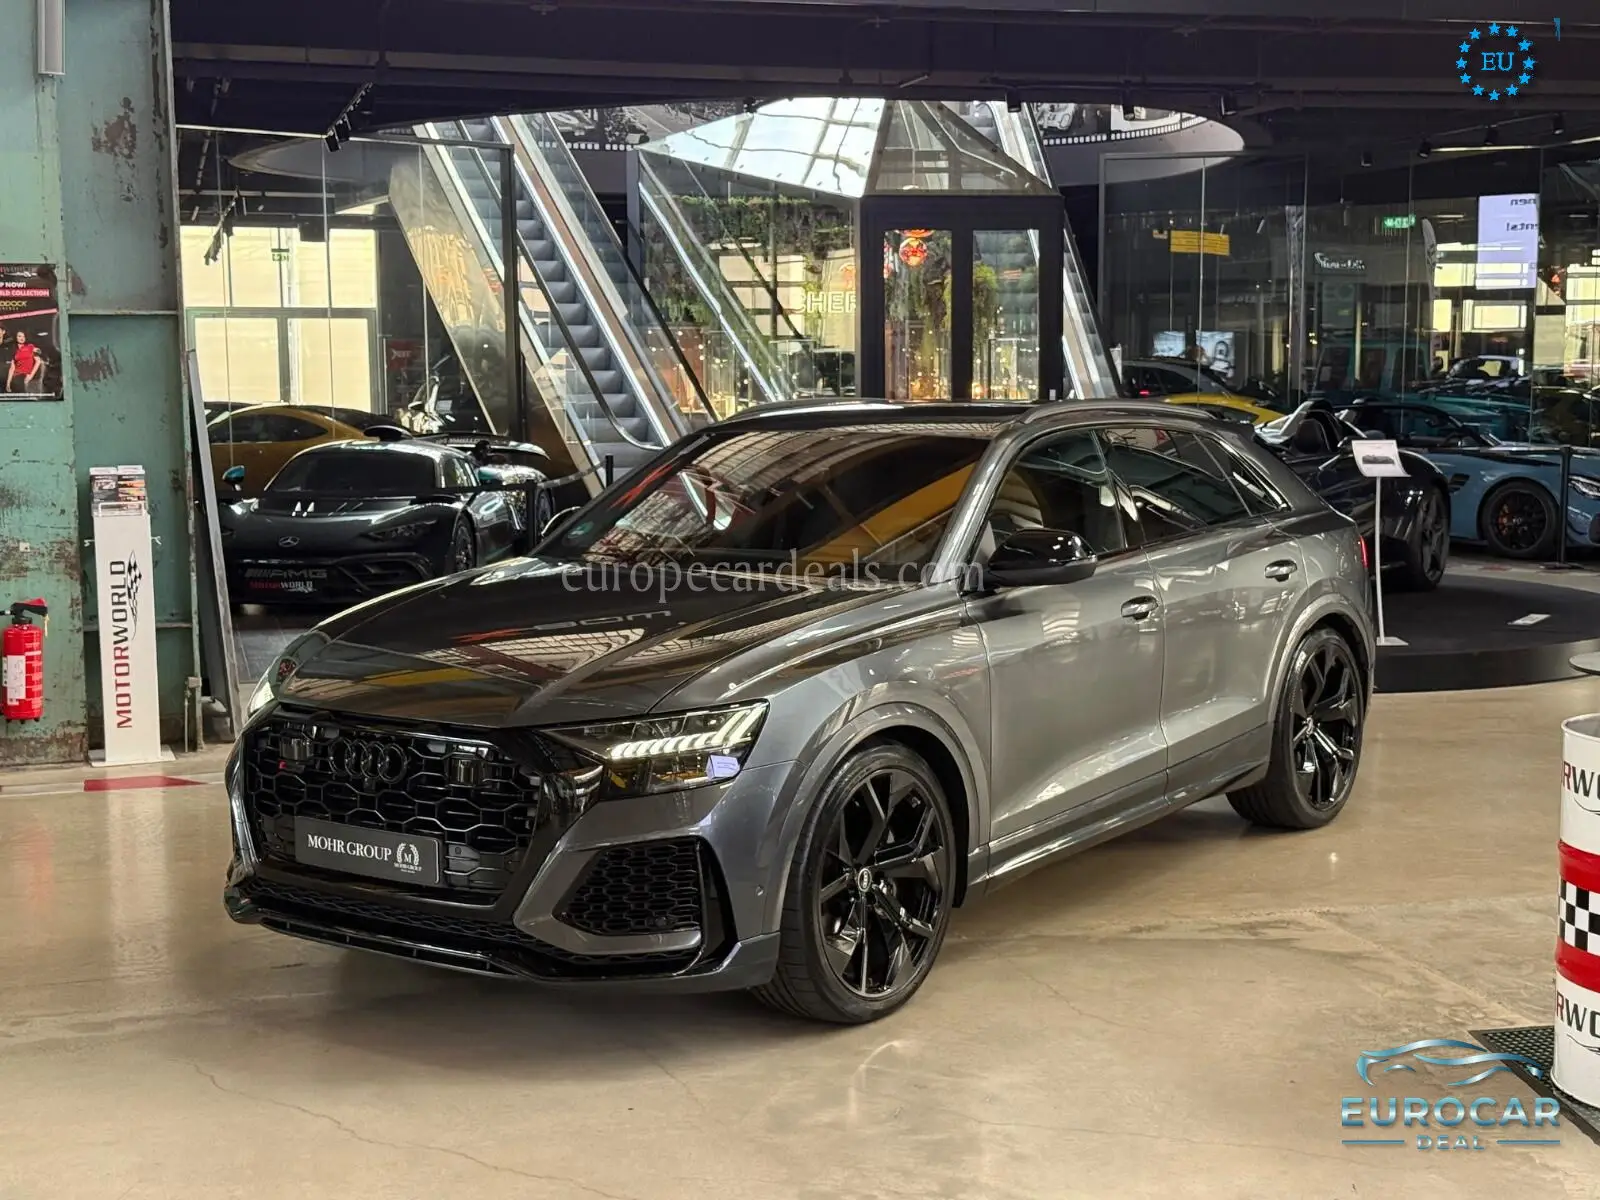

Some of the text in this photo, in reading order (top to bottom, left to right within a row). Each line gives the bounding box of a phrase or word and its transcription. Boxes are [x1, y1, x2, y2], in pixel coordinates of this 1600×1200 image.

[110, 560, 133, 729] MOTORWORLD
[307, 834, 392, 861] MOHR GROUP
